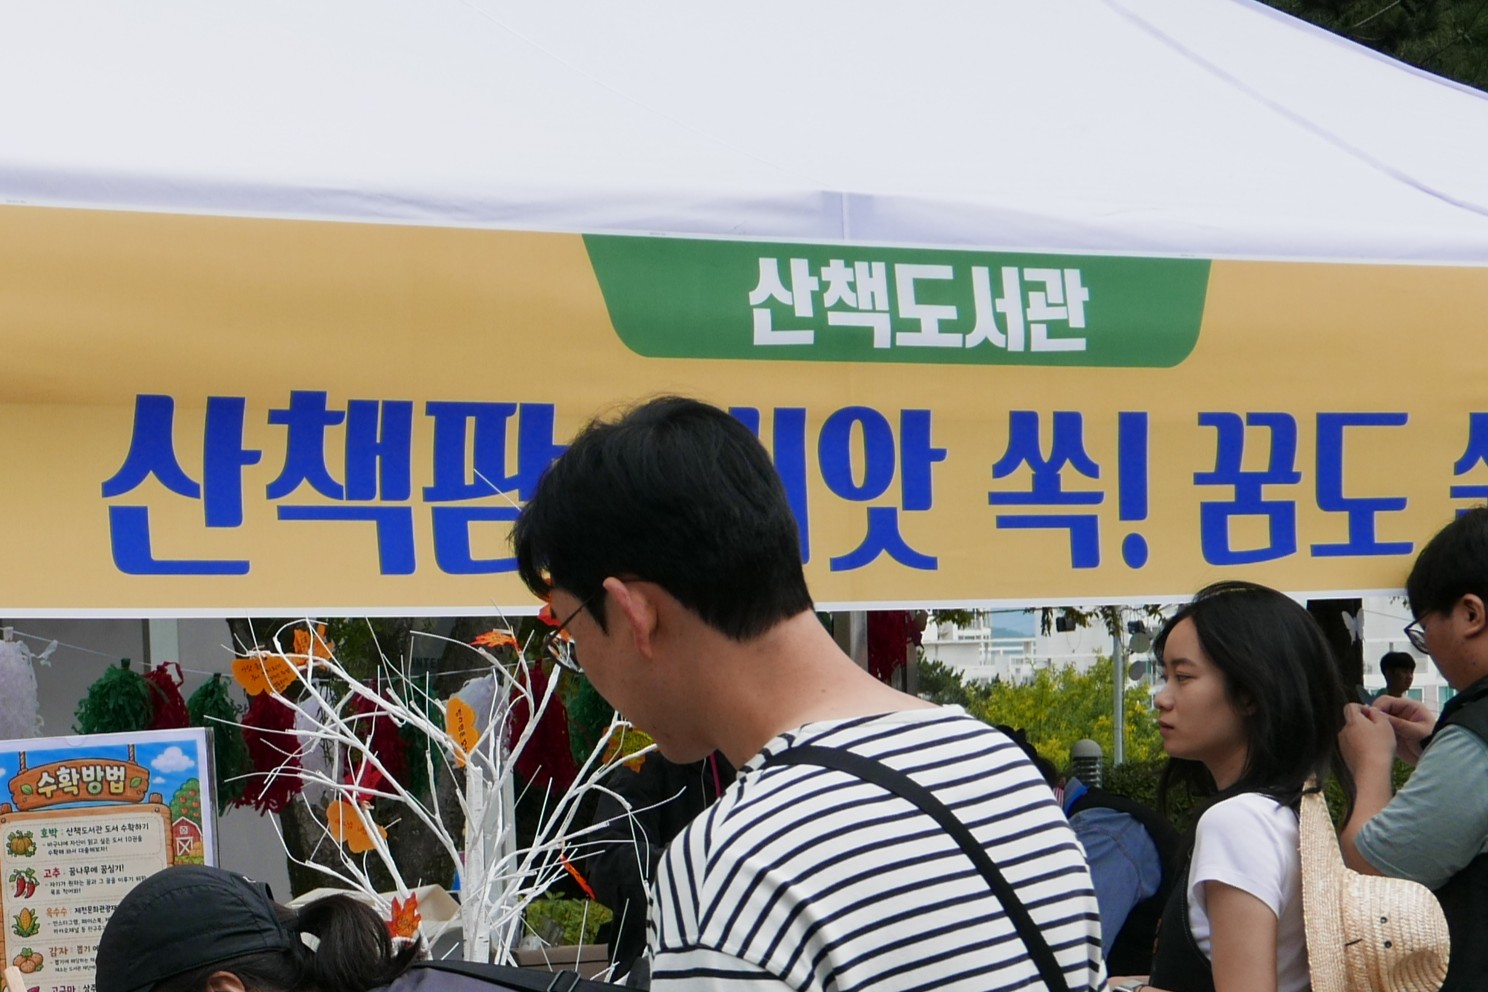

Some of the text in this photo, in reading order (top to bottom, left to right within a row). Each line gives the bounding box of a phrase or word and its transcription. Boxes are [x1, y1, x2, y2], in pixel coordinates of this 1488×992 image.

[748, 256, 1091, 356] 산책도서관
[988, 408, 1149, 570] 쏙!
[1192, 410, 1414, 566] 꿈도
[37, 764, 128, 799] 수확방법
[40, 827, 58, 838] 호박
[104, 824, 119, 834] 도서
[120, 822, 149, 833] 수확하기
[43, 867, 61, 878] 고추
[46, 907, 68, 918] 옥수수
[48, 946, 68, 957] 감자
